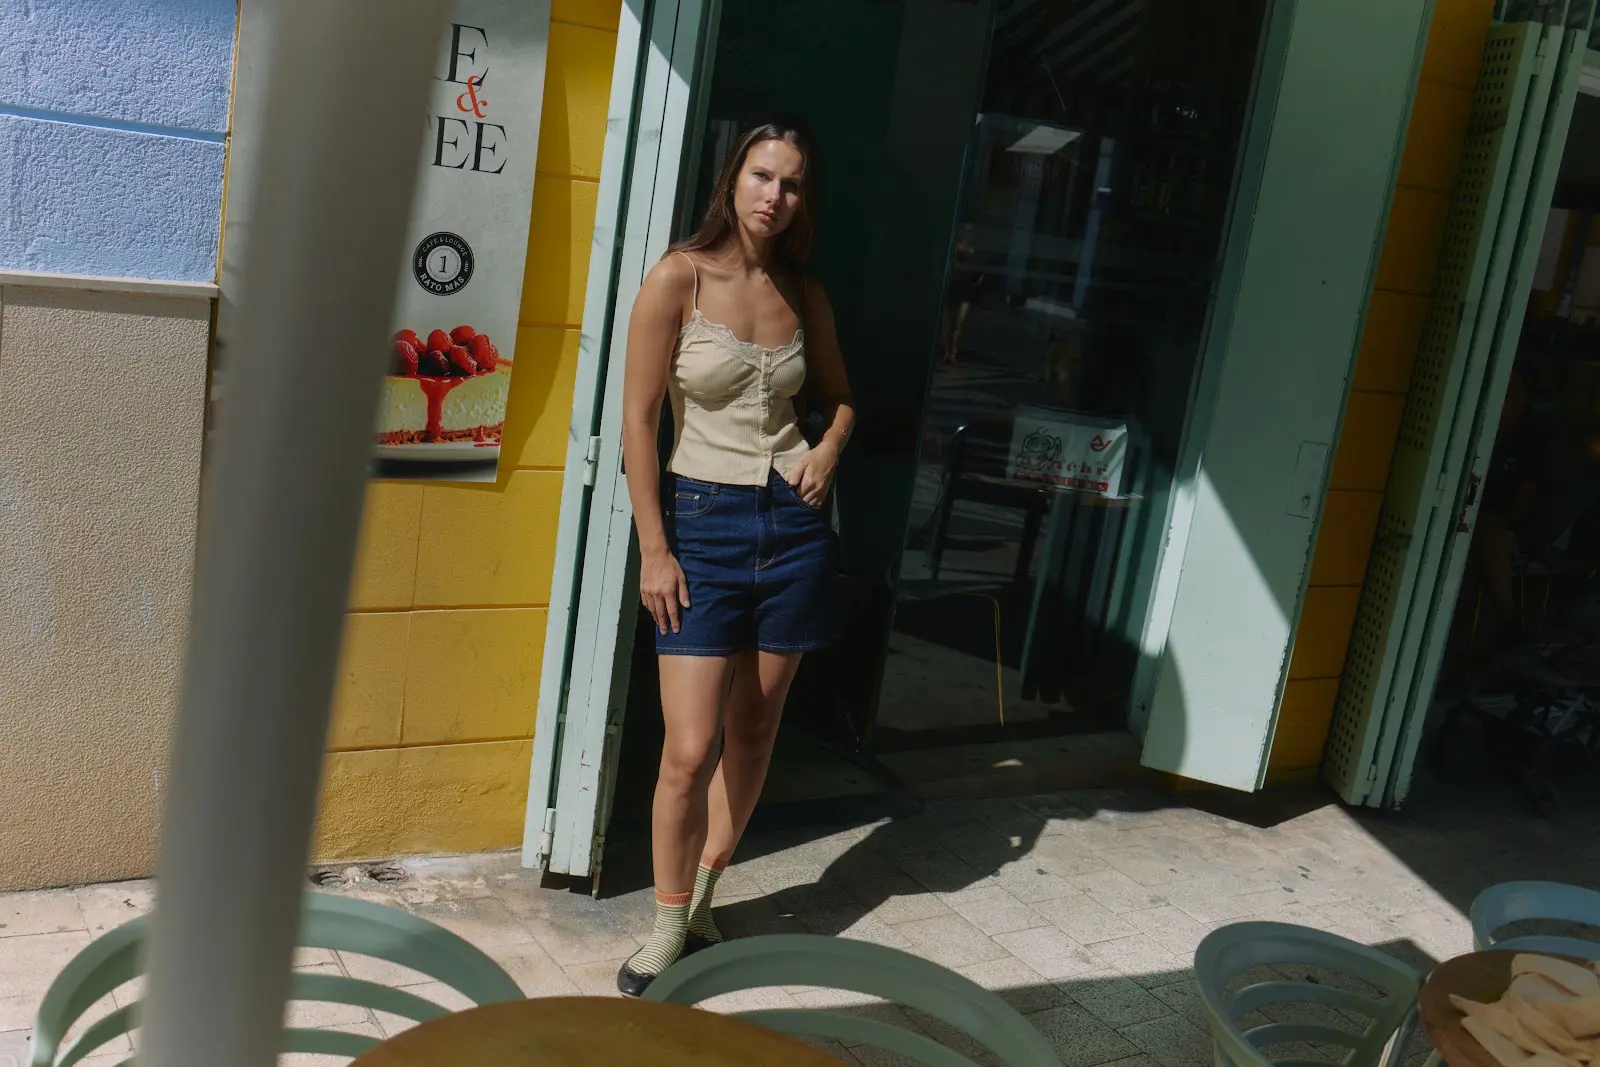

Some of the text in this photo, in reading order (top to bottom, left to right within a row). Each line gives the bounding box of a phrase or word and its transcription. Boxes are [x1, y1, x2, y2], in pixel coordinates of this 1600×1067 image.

[433, 23, 489, 86] E
[456, 75, 488, 119] &
[425, 115, 507, 174] EE
[445, 237, 468, 257] LOUNGE
[438, 255, 448, 274] 1
[420, 273, 442, 291] RATO
